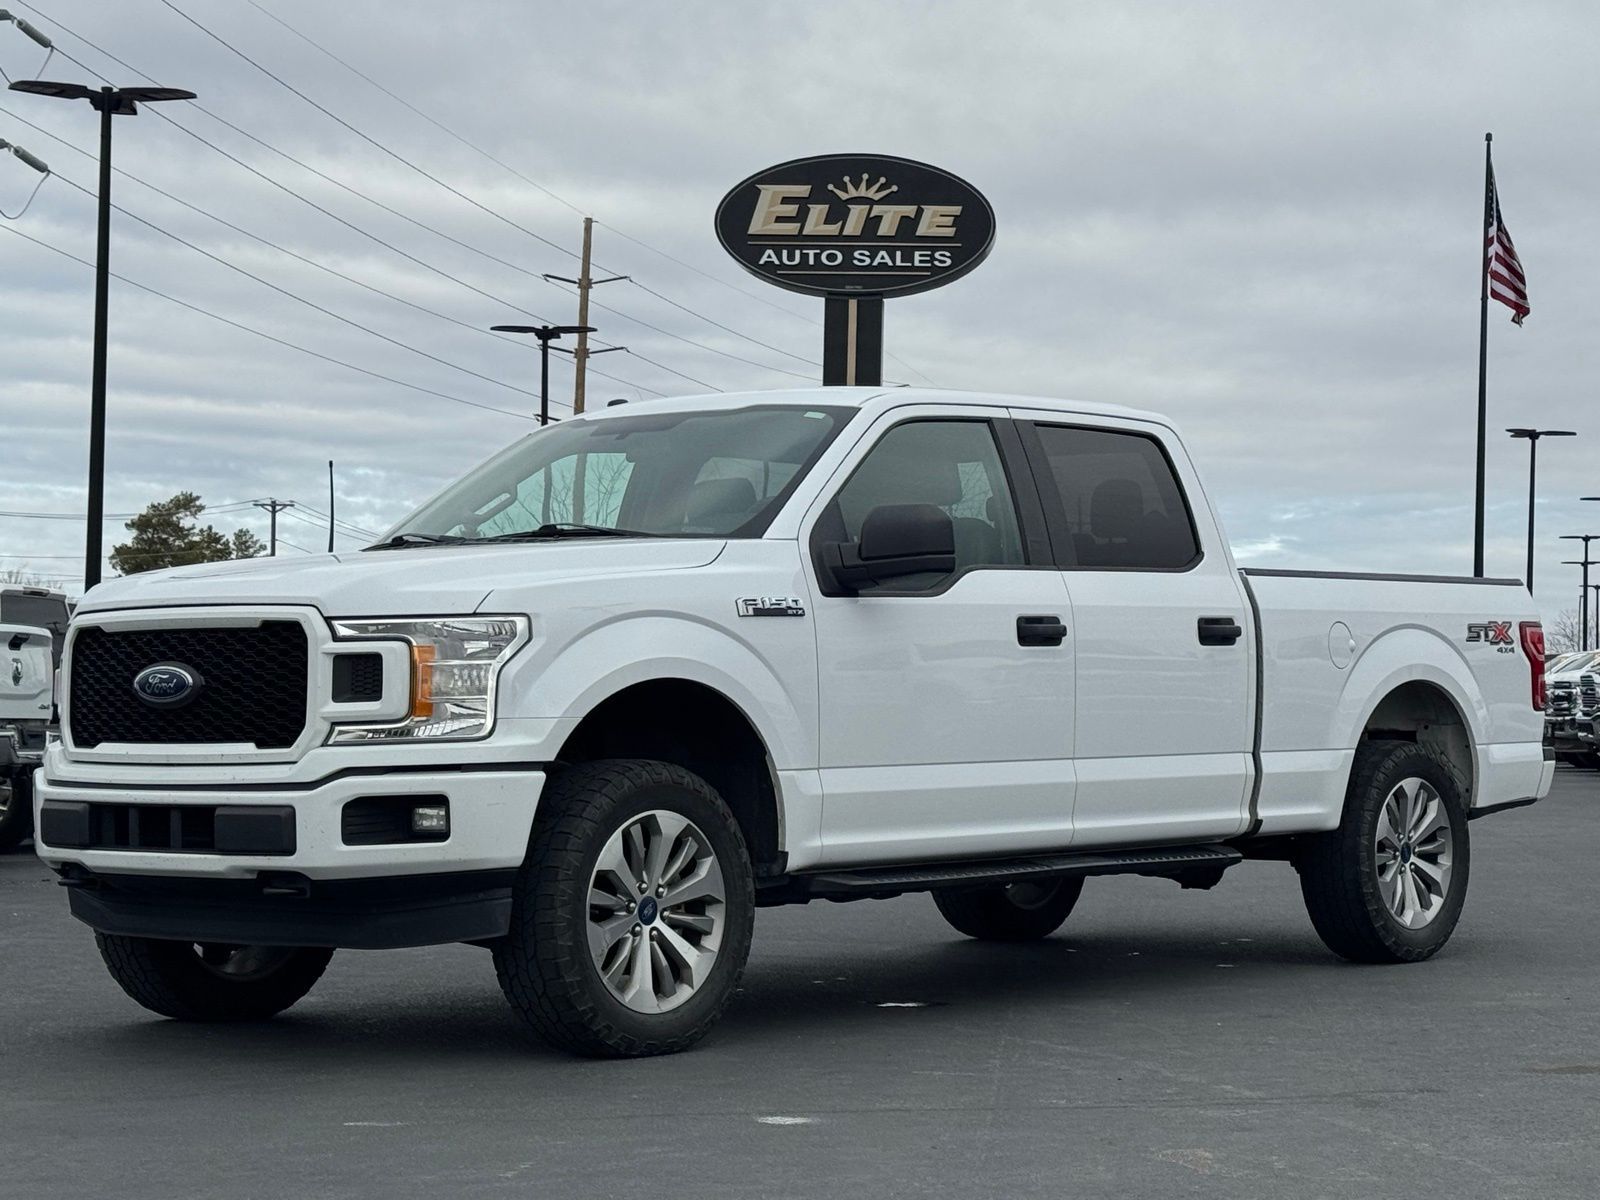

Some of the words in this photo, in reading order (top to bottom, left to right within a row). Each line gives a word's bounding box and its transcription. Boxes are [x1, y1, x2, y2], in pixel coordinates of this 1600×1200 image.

[747, 184, 964, 238] ELITE
[758, 249, 843, 266] AUTO
[852, 250, 953, 268] SALES
[1466, 621, 1514, 645] STX
[145, 673, 177, 694] Ford
